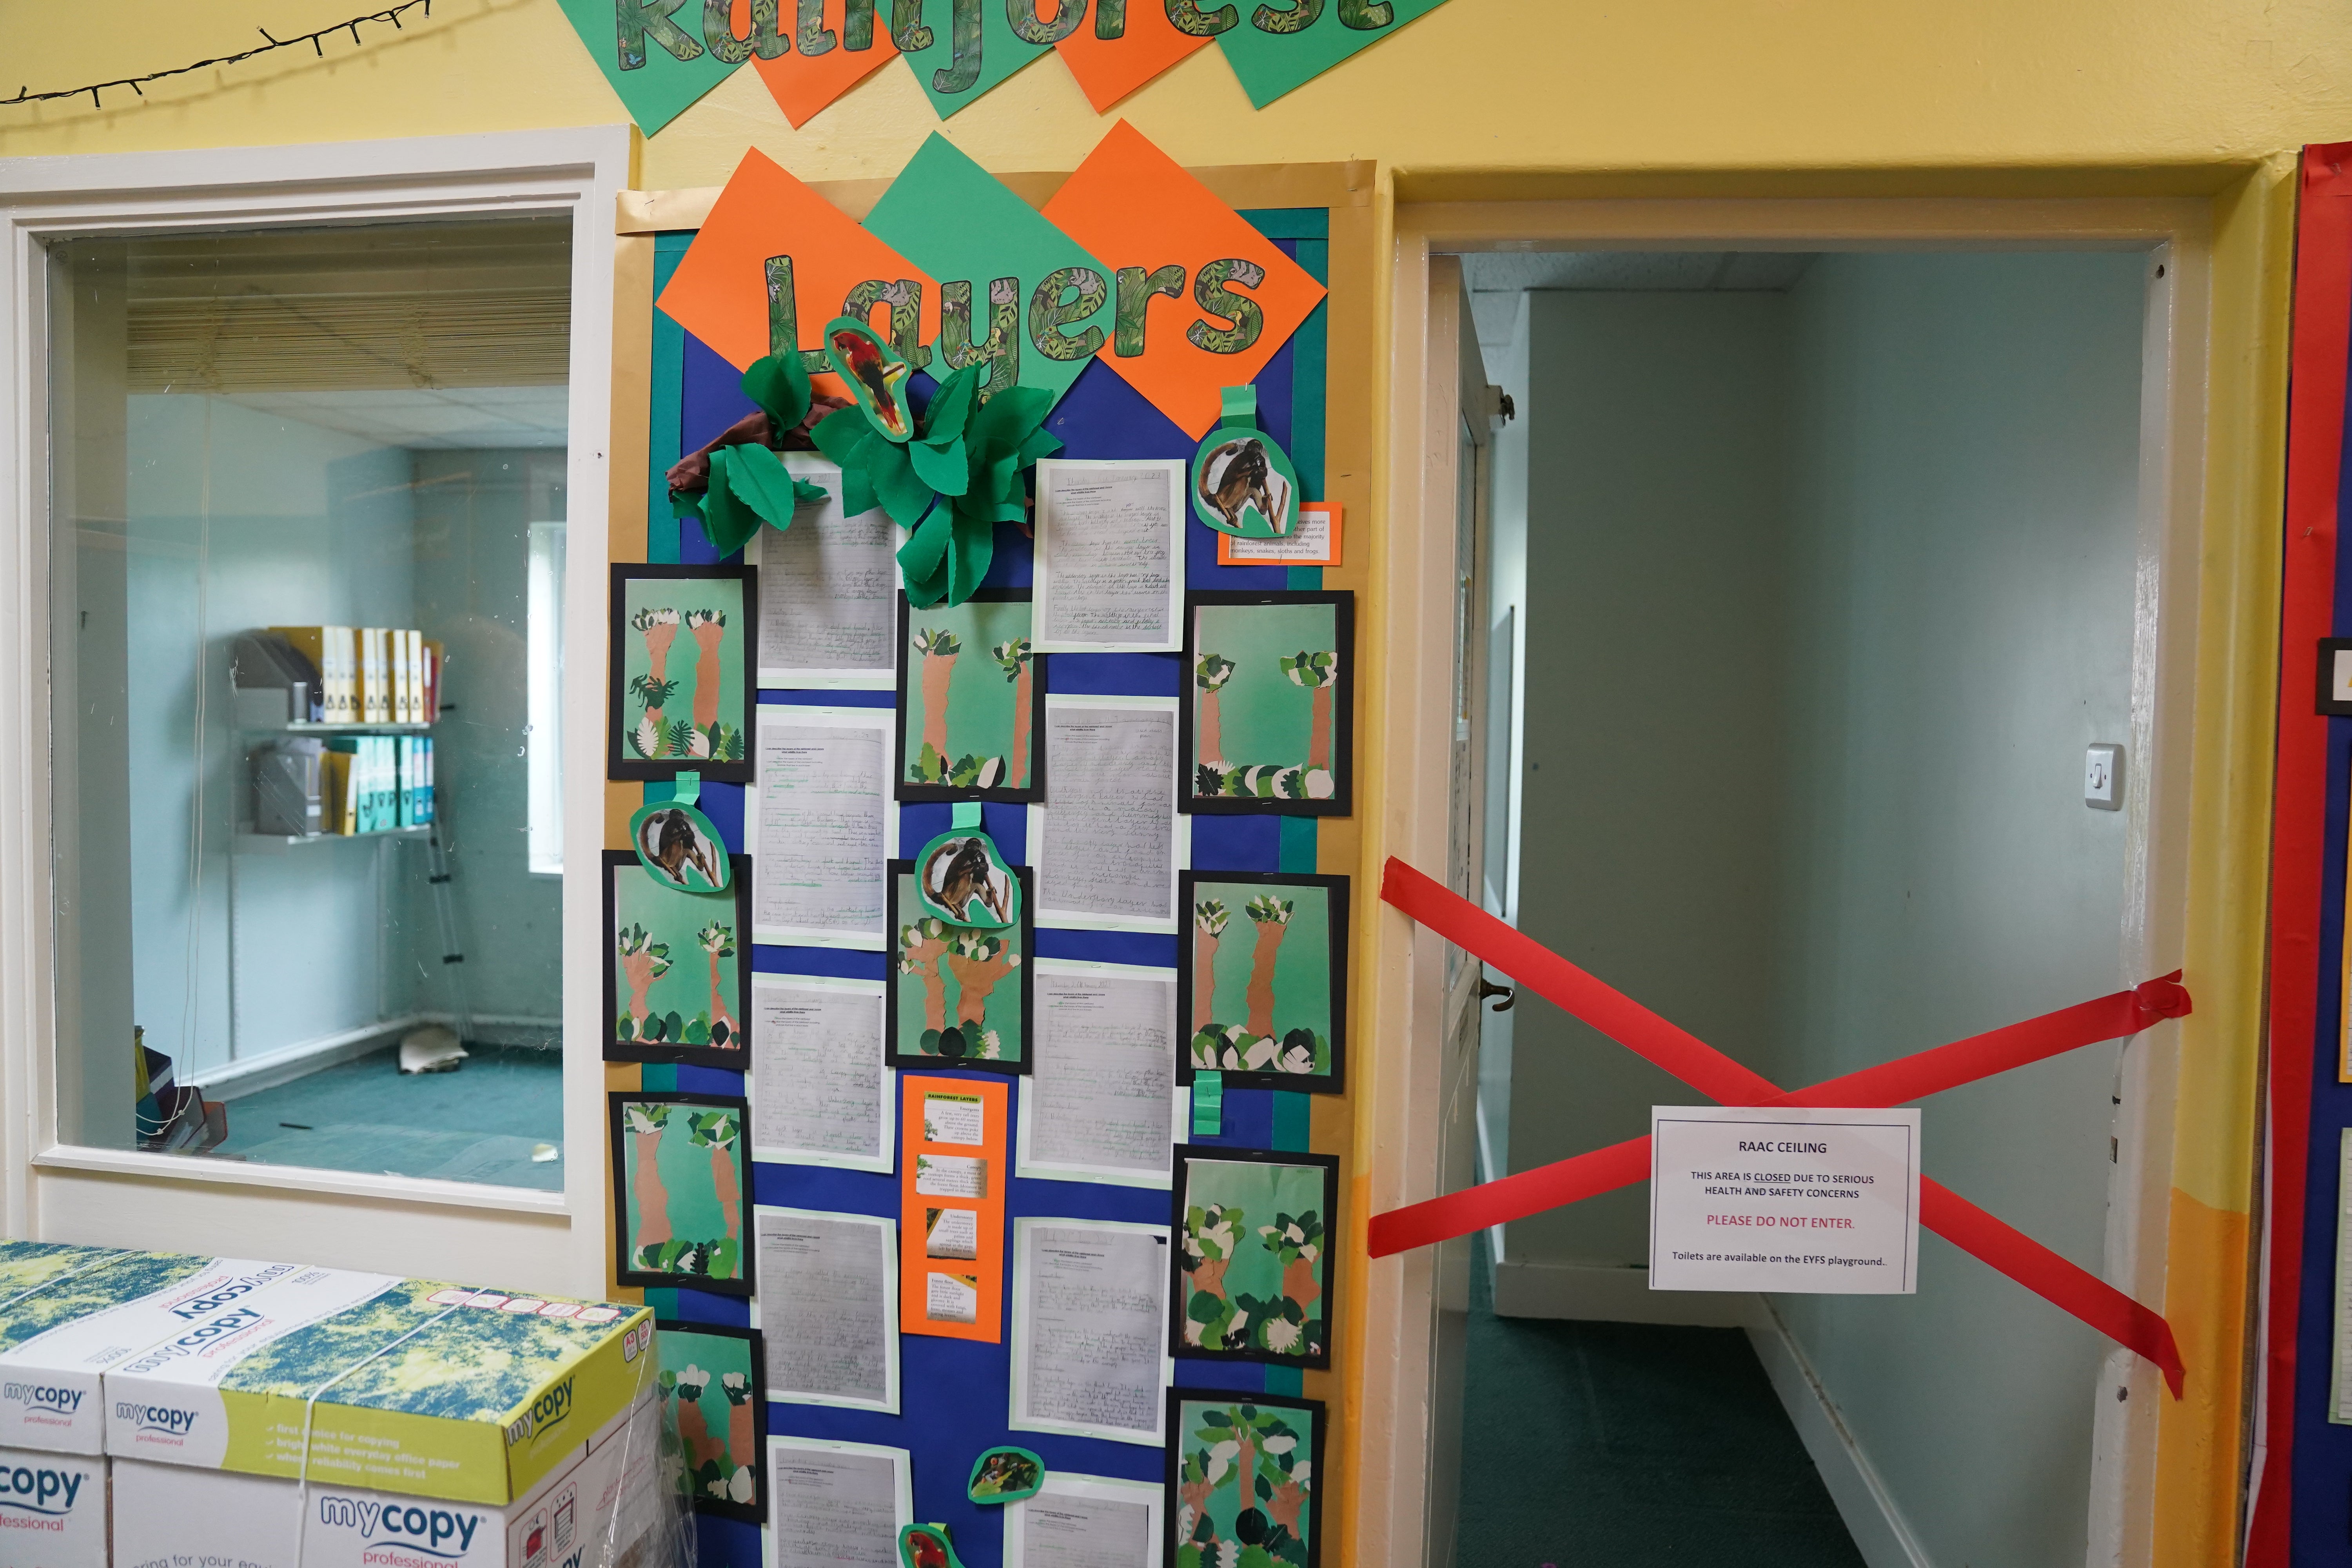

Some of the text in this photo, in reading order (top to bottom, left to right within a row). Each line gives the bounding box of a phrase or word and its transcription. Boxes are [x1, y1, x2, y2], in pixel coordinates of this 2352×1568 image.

[765, 255, 1266, 409] Layers
[1739, 1141, 1827, 1153] RAAC CEILING
[1691, 1171, 1874, 1184] THIS AREA IS CLOSED DUE TO SERIOUS
[1705, 1186, 1859, 1199] HEALTH AND SAFETY CONCERNS
[1707, 1214, 1855, 1229] PLEASE DO NOT ENTER.
[1673, 1252, 1704, 1261] Toilets
[1724, 1253, 1767, 1262] available
[1784, 1254, 1800, 1263] the
[1804, 1255, 1825, 1264] EYFS
[24, 1416, 72, 1427] professional
[136, 1434, 183, 1446] professional
[276, 1424, 298, 1435] first
[340, 1431, 355, 1441] for
[358, 1435, 399, 1449] copying
[311, 1443, 341, 1454] white
[344, 1448, 391, 1462] everyday
[394, 1453, 425, 1465] office
[428, 1458, 460, 1469] paper
[313, 1457, 361, 1472] reliability
[365, 1464, 400, 1475] comes
[403, 1468, 426, 1479] first
[173, 1554, 193, 1567] for
[199, 1555, 233, 1568] your
[363, 1552, 458, 1568] professional
